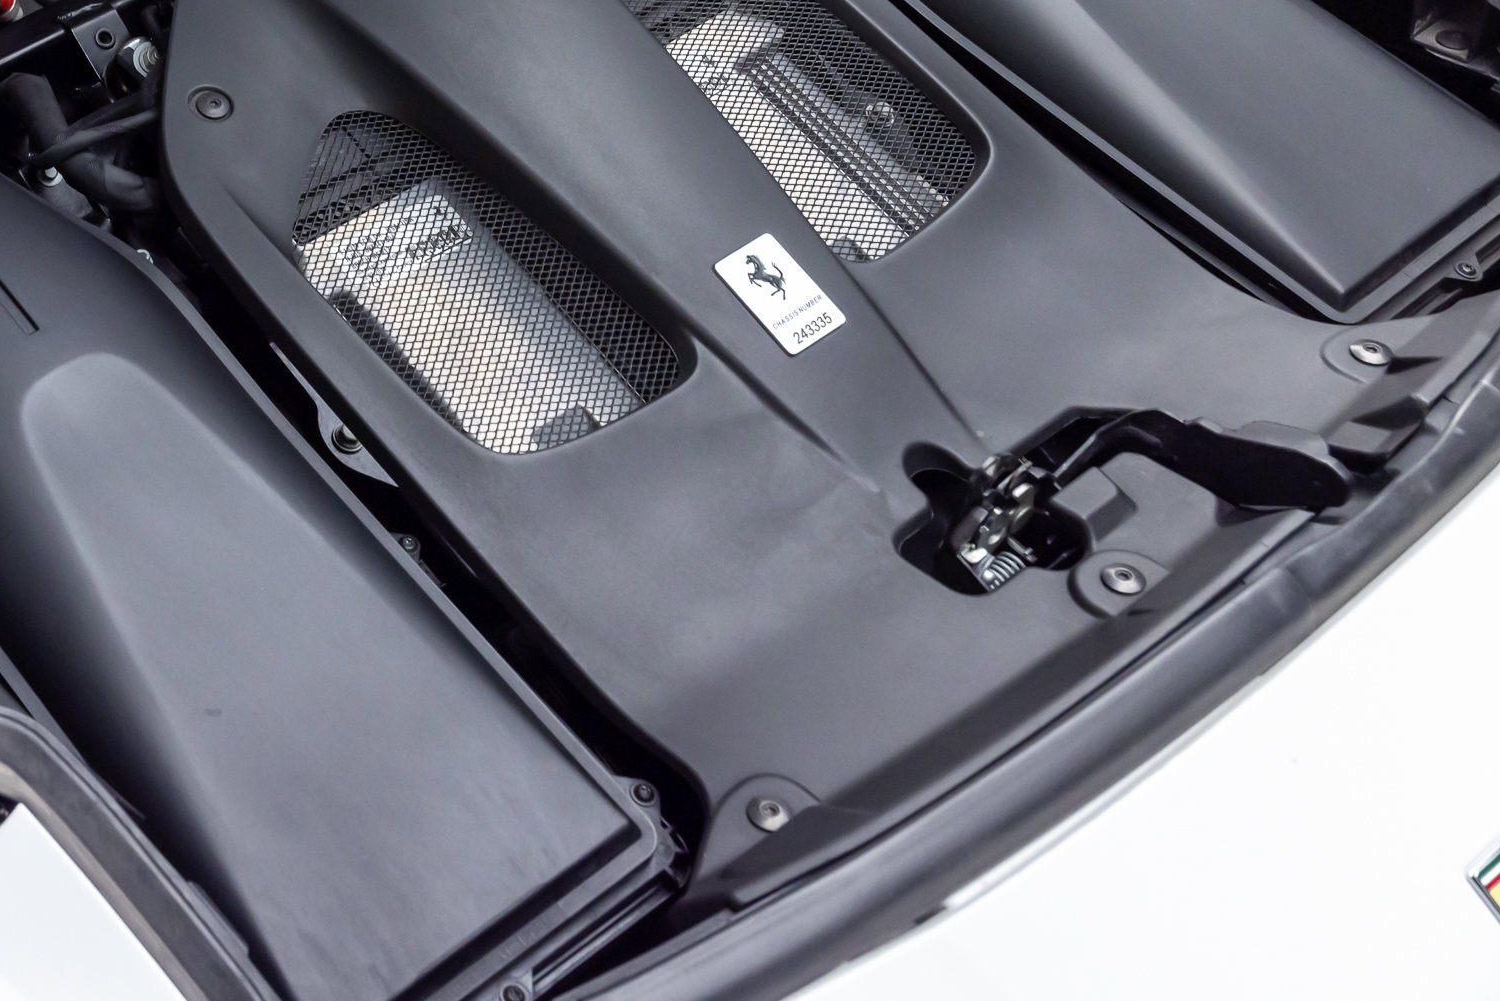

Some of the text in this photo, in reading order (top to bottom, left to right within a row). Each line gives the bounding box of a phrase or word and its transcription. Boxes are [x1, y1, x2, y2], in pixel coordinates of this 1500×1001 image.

[772, 294, 823, 330] CHASSIS NUMBER
[793, 312, 833, 345] 243335
